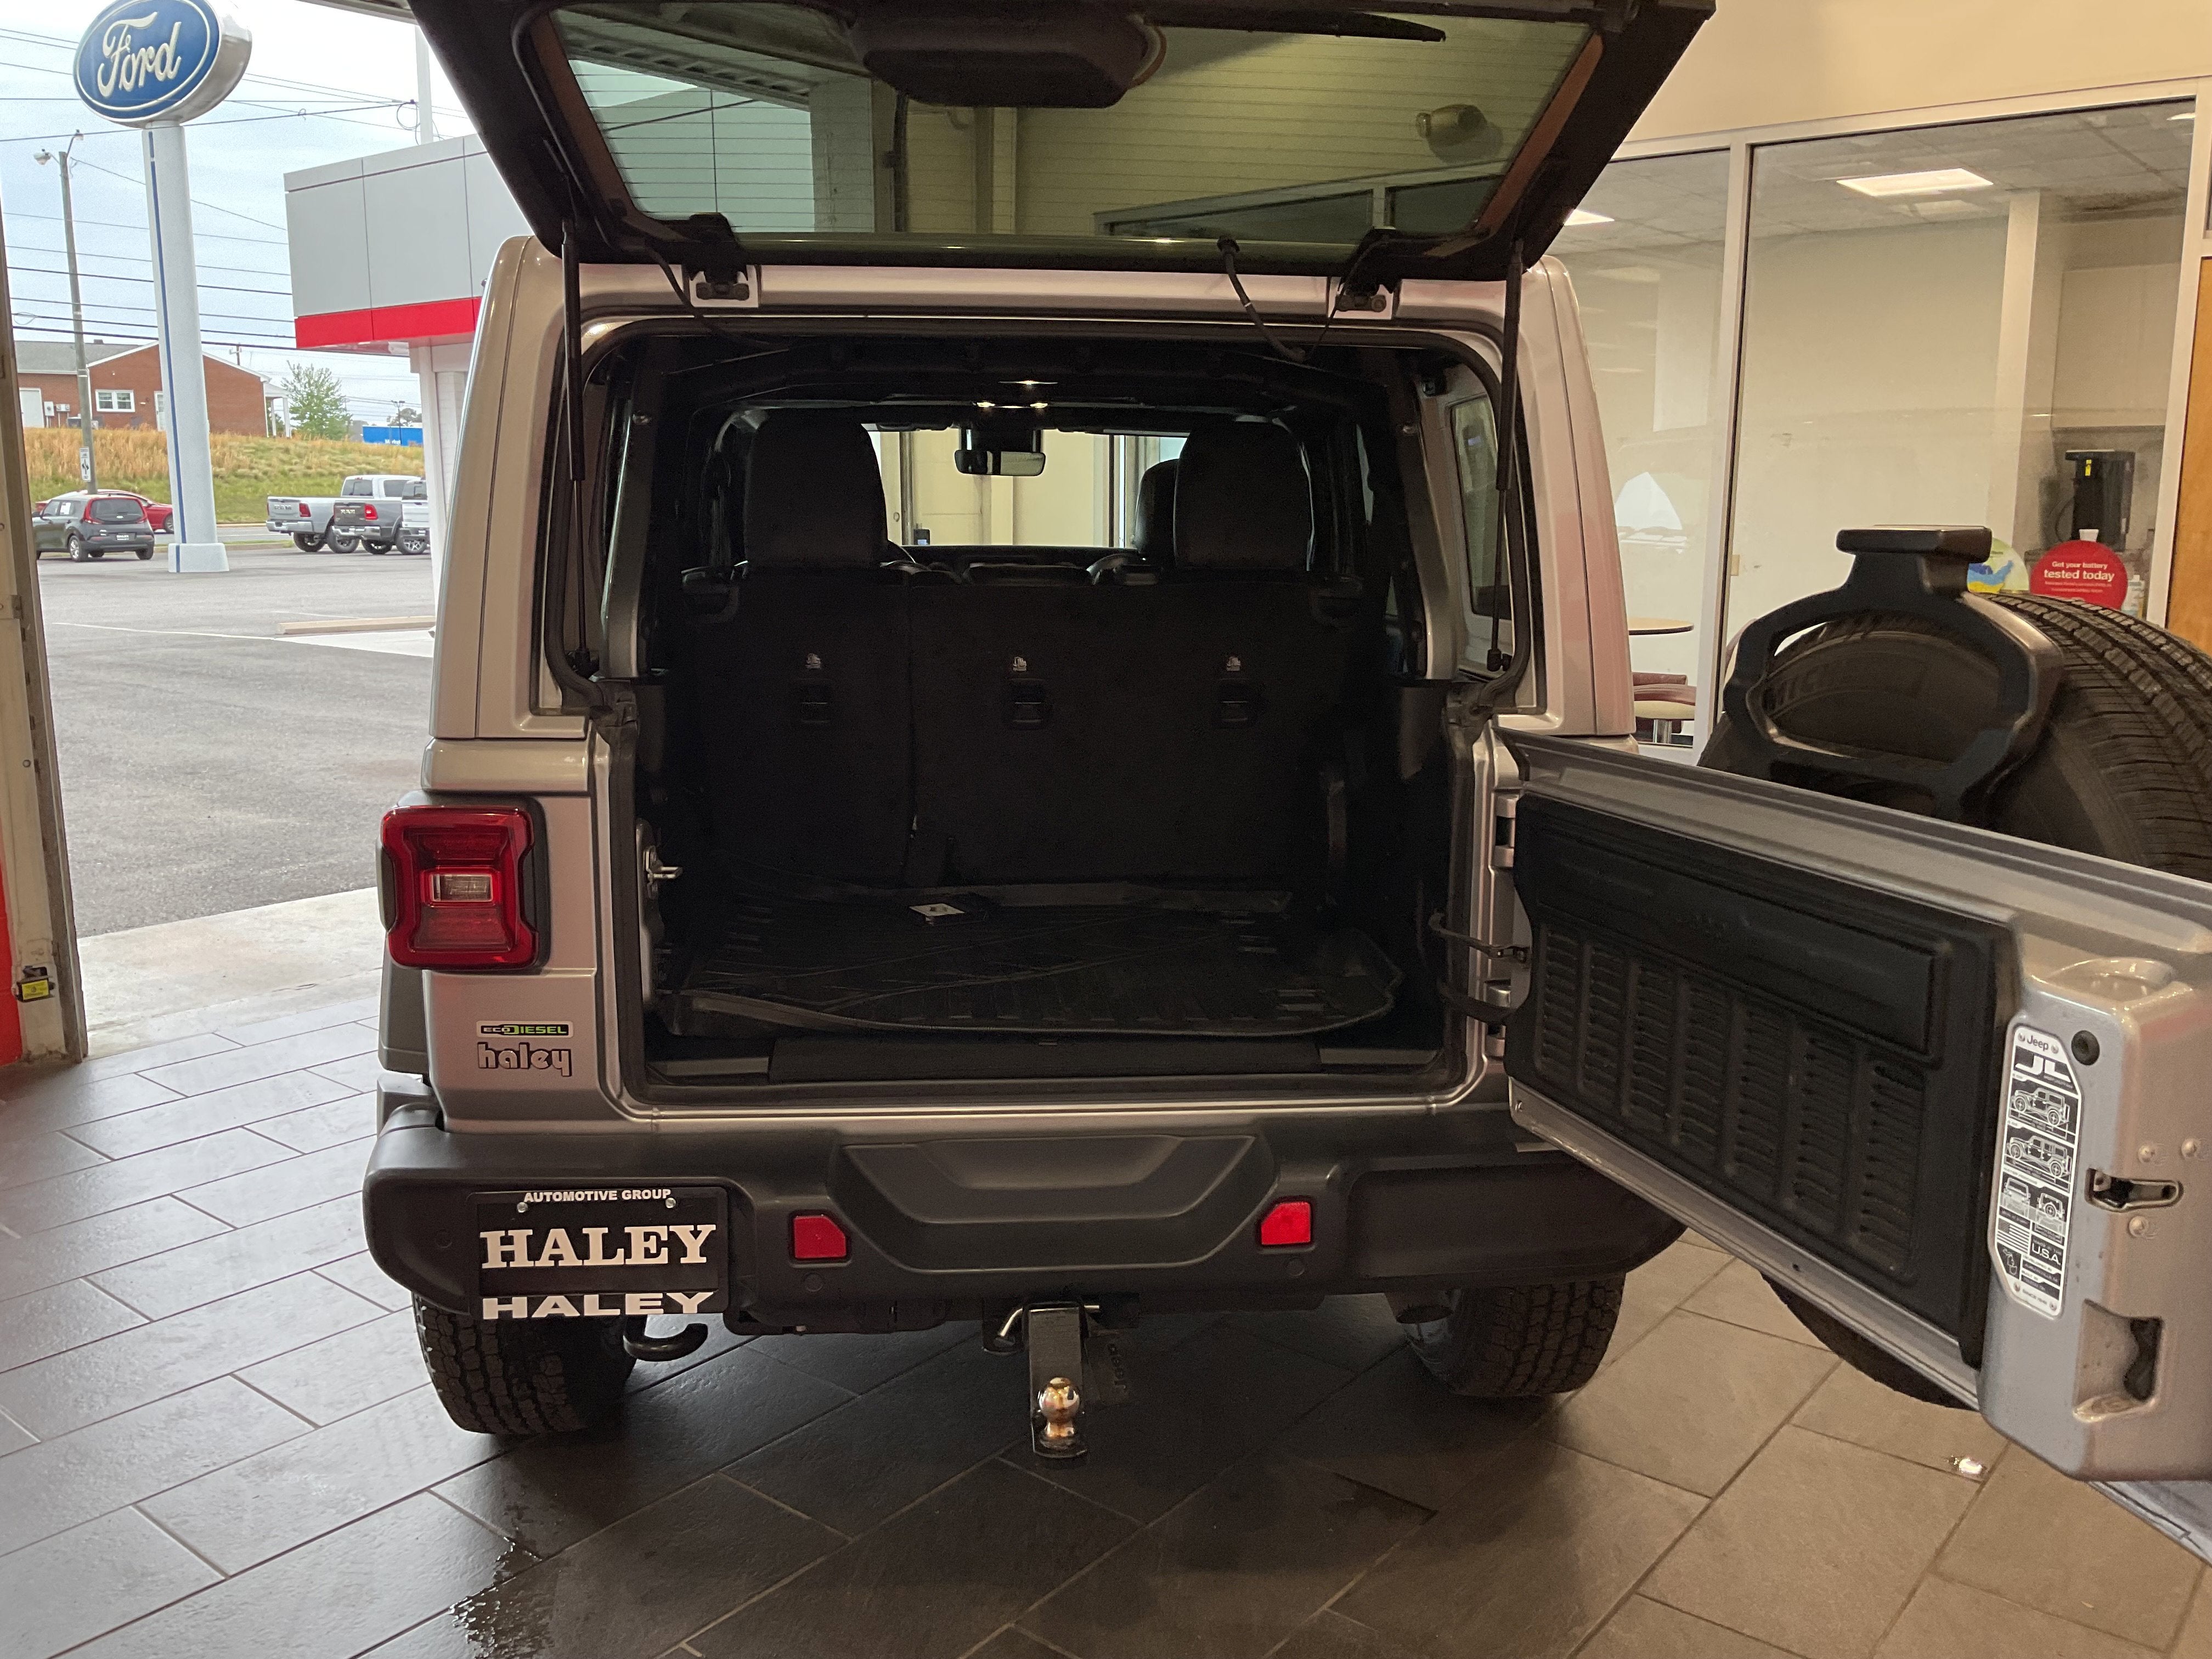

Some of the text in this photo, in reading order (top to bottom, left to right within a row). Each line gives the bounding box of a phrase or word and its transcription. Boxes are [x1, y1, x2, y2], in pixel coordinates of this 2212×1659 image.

[98, 12, 182, 98] Ford
[2044, 569, 2115, 582] tested today
[2027, 1035, 2049, 1051] Jeep
[477, 1042, 572, 1077] haley
[2015, 1055, 2072, 1083] JL
[523, 1188, 672, 1203] AUTOMOTIVE GROUP
[479, 1224, 716, 1269] HALEY
[2032, 1243, 2061, 1266] U.S.A.
[483, 1291, 714, 1319] HALEY
